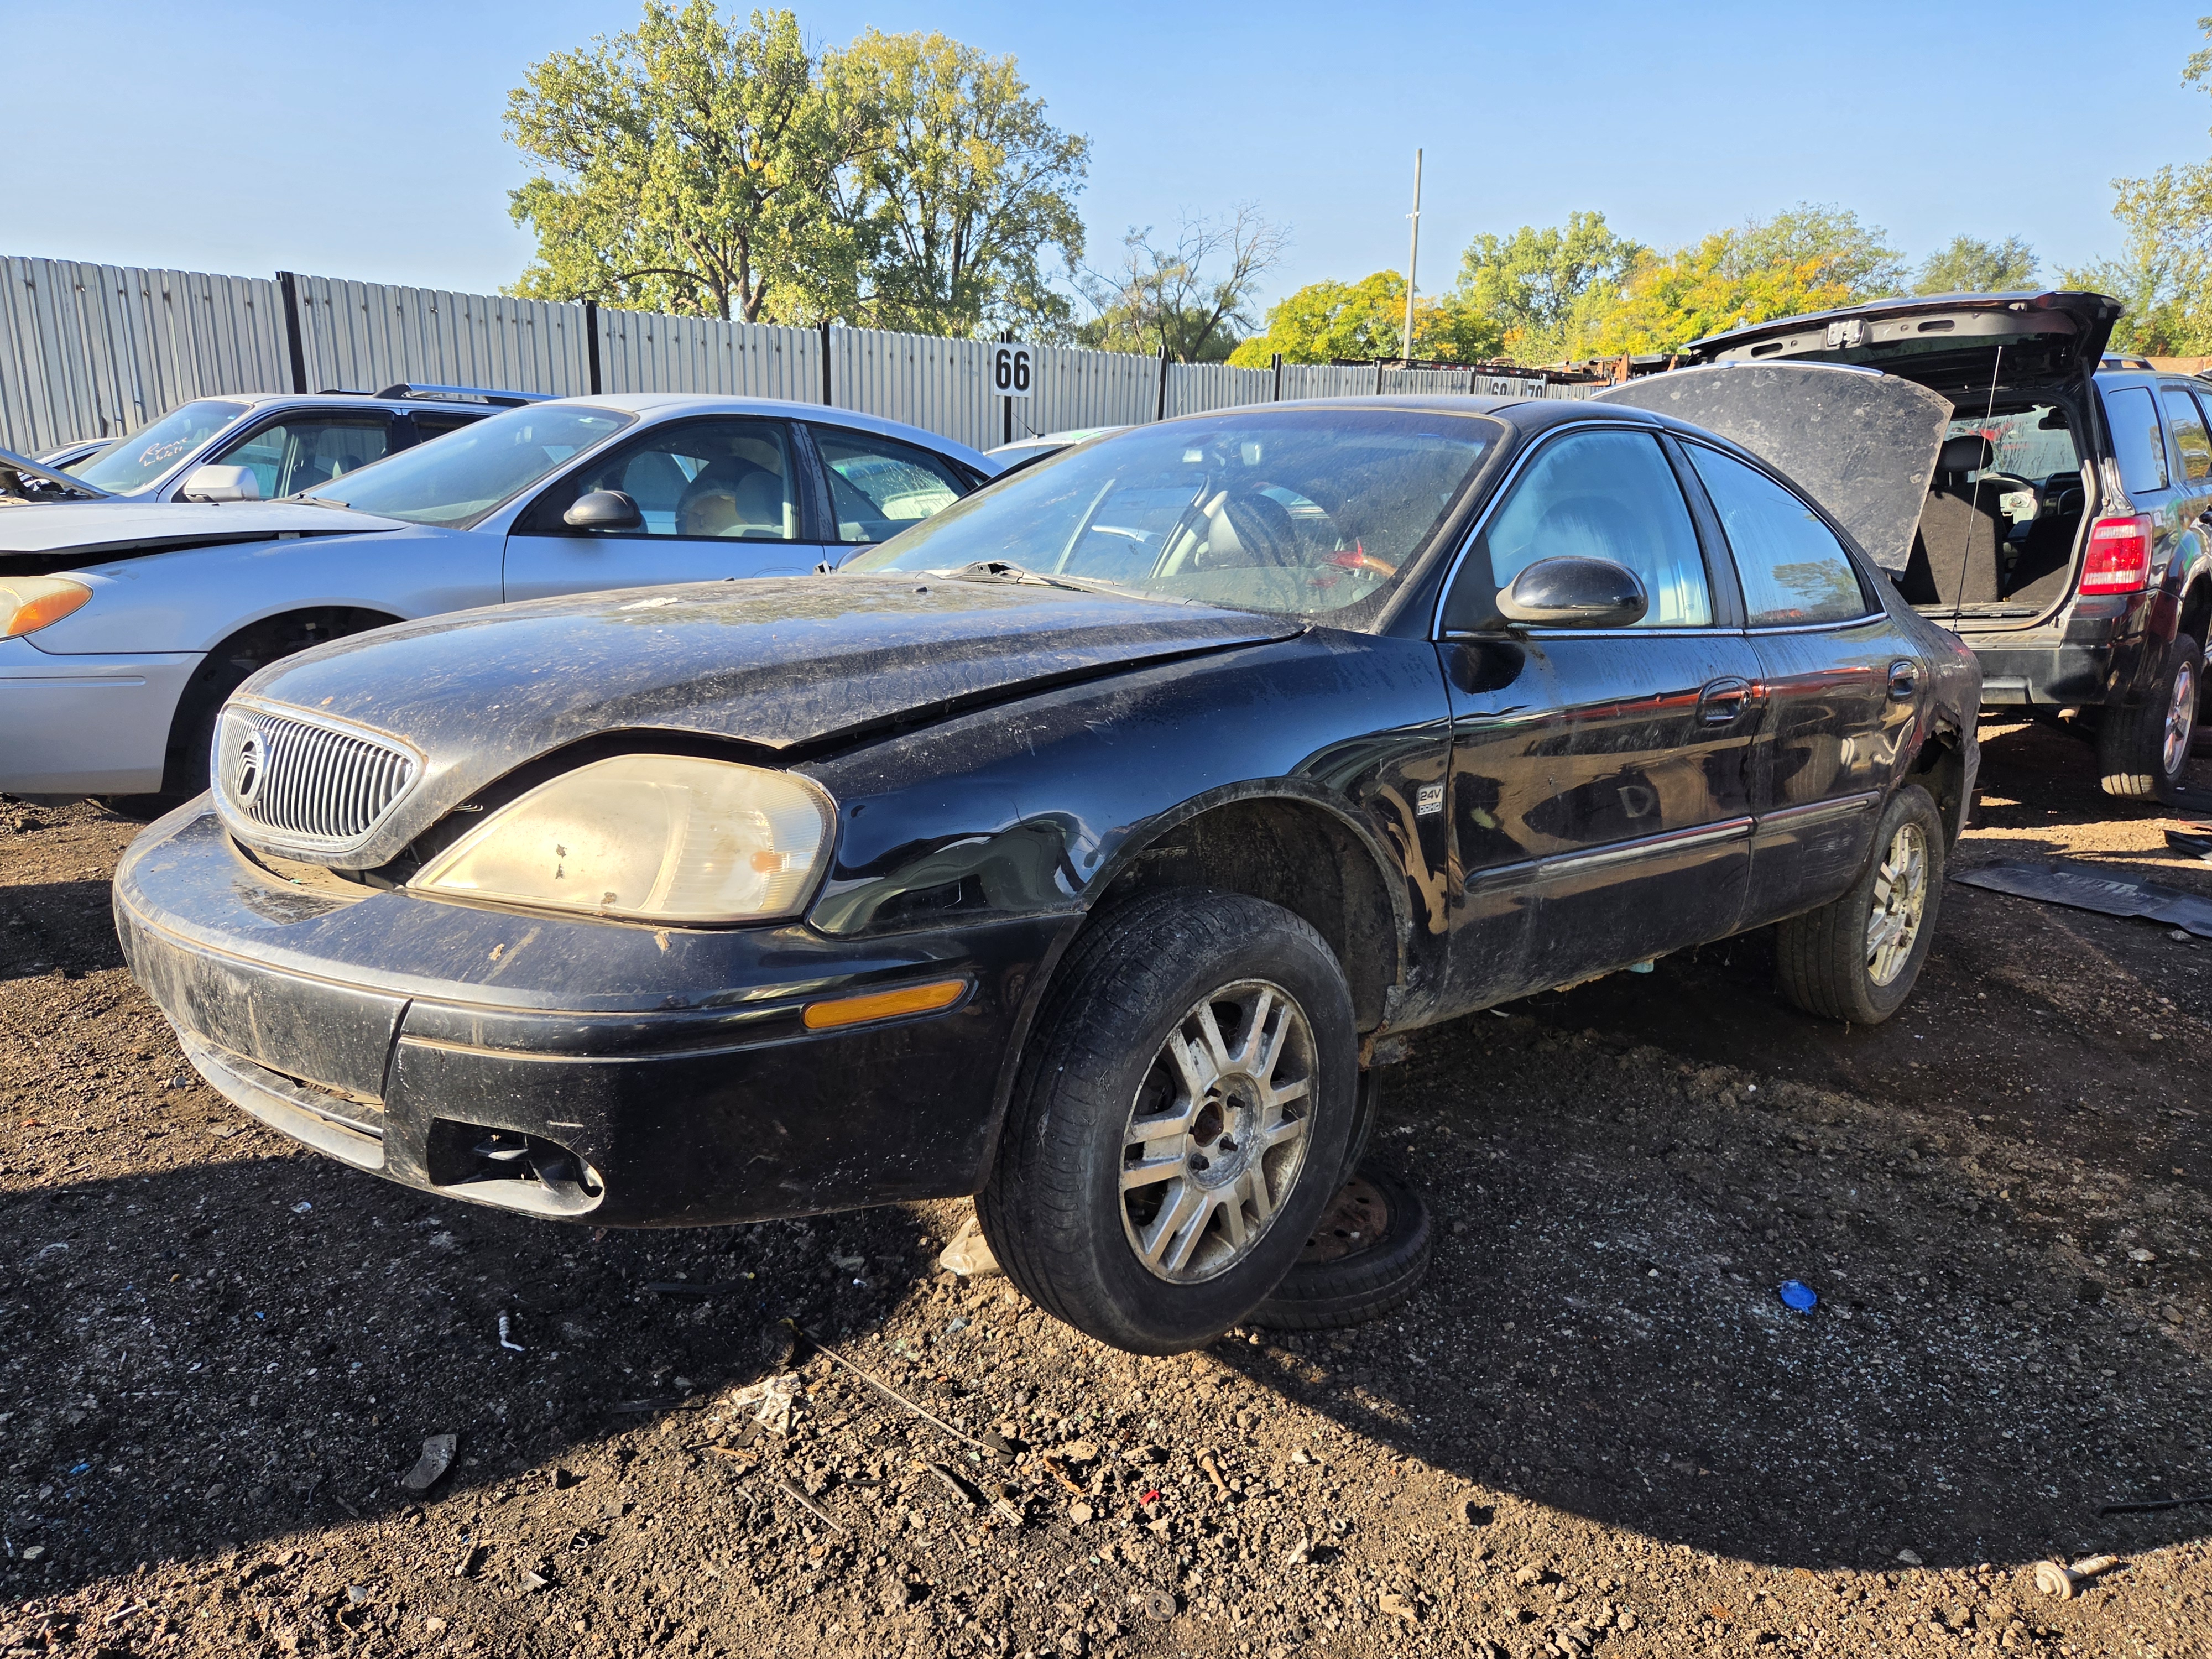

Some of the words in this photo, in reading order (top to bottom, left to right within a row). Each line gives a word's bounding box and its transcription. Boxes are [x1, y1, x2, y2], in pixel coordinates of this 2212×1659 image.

[996, 349, 1030, 392] 66
[1528, 385, 1542, 398] 70
[1420, 788, 1441, 801] 24V
[1419, 802, 1440, 813] DOHC
